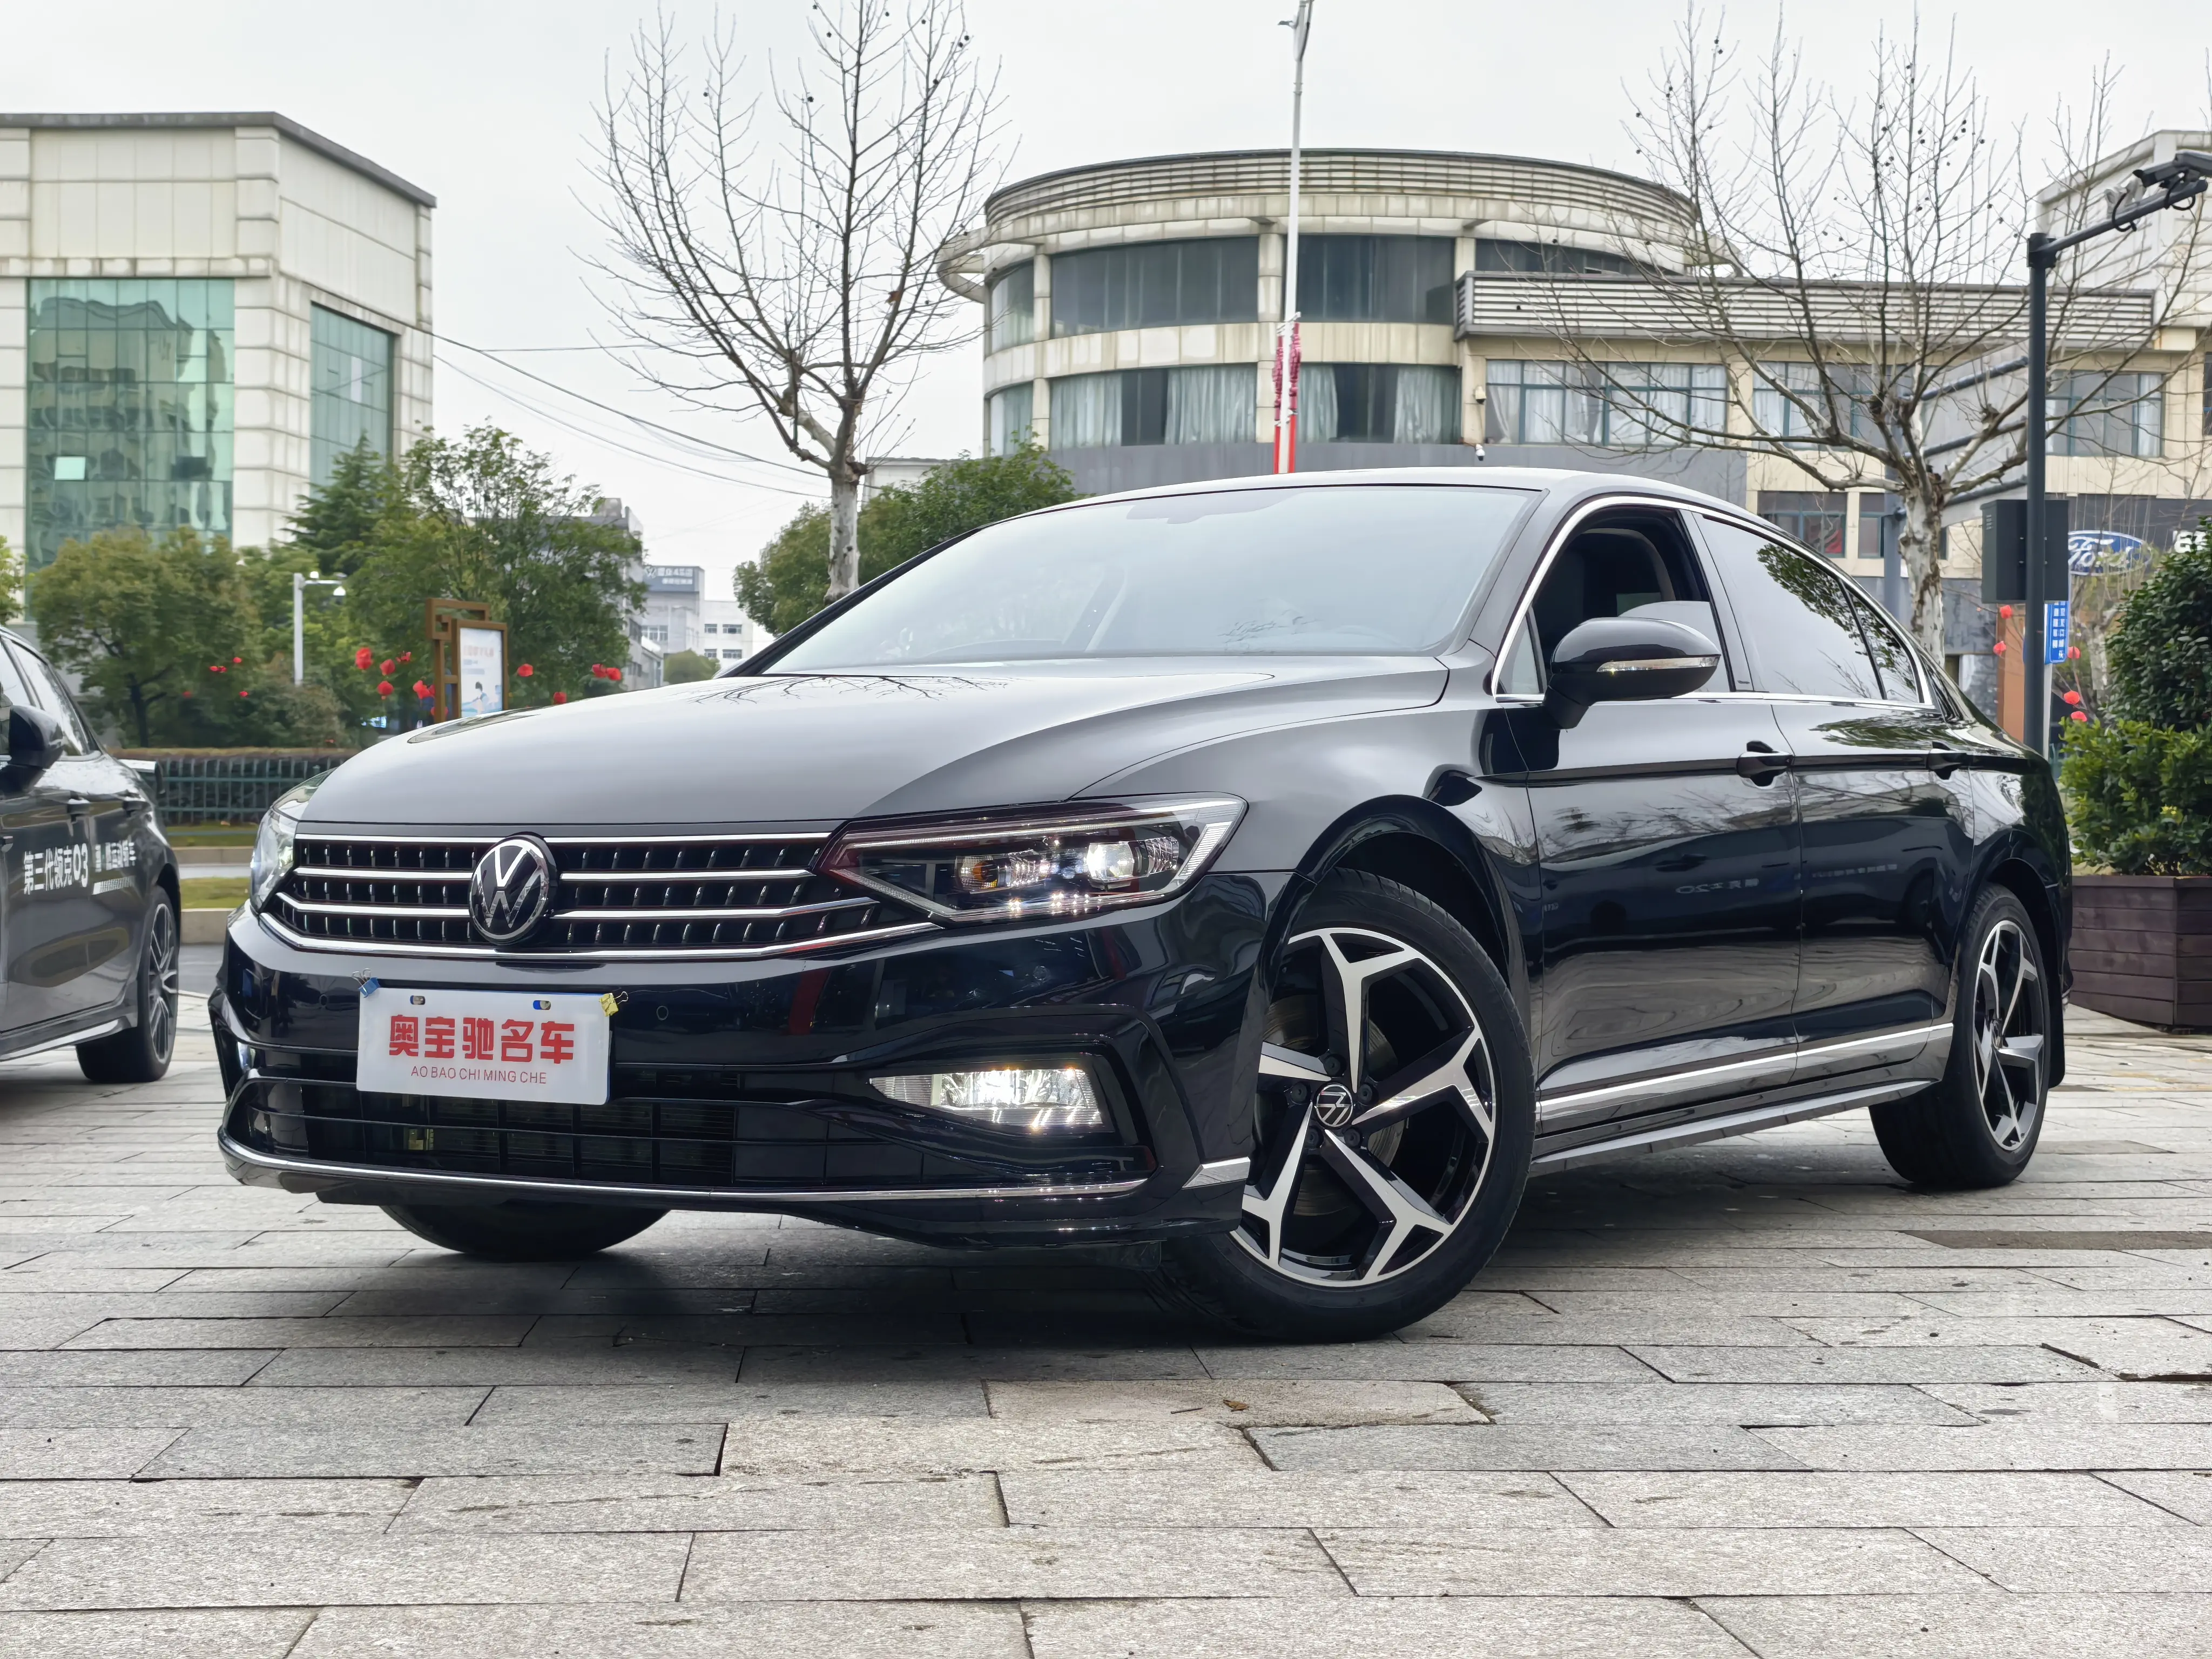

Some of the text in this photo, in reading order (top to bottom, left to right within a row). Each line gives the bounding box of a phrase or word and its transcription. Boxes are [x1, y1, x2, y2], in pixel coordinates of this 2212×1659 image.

[388, 1014, 575, 1064] 奥宝驰名车
[410, 1065, 547, 1084] AO BAO CHI MING CHE
